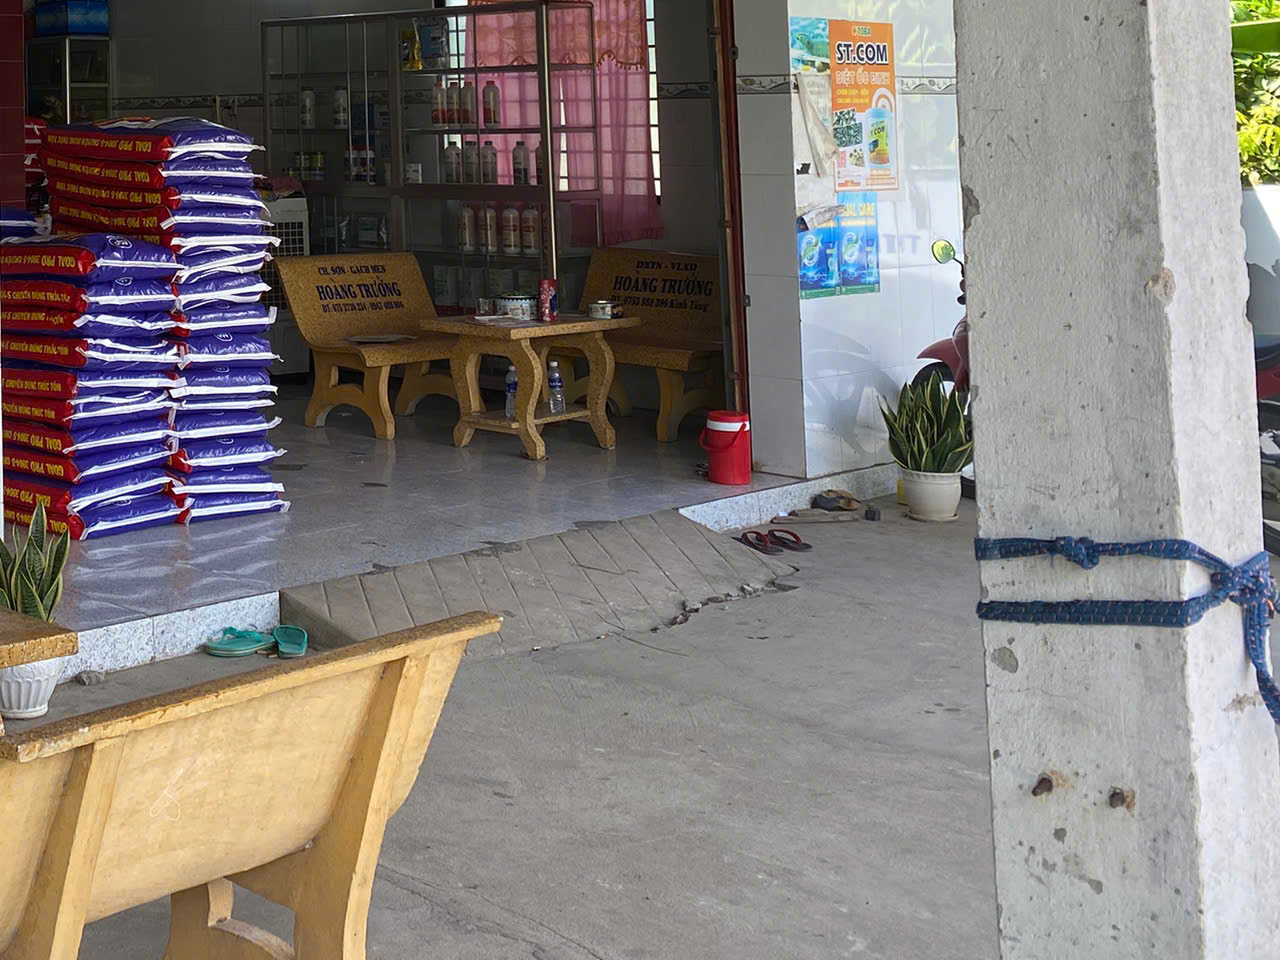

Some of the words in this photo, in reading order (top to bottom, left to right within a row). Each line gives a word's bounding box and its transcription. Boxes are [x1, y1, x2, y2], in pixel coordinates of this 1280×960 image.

[835, 41, 889, 66] ST.COM
[135, 141, 152, 152] GOAL
[41, 255, 56, 267] PRO
[58, 256, 76, 268] GOAL
[613, 270, 658, 293] HOÀNG
[316, 278, 357, 301] HOÀNG
[30, 434, 44, 448] PRO
[45, 437, 62, 451] GOAL
